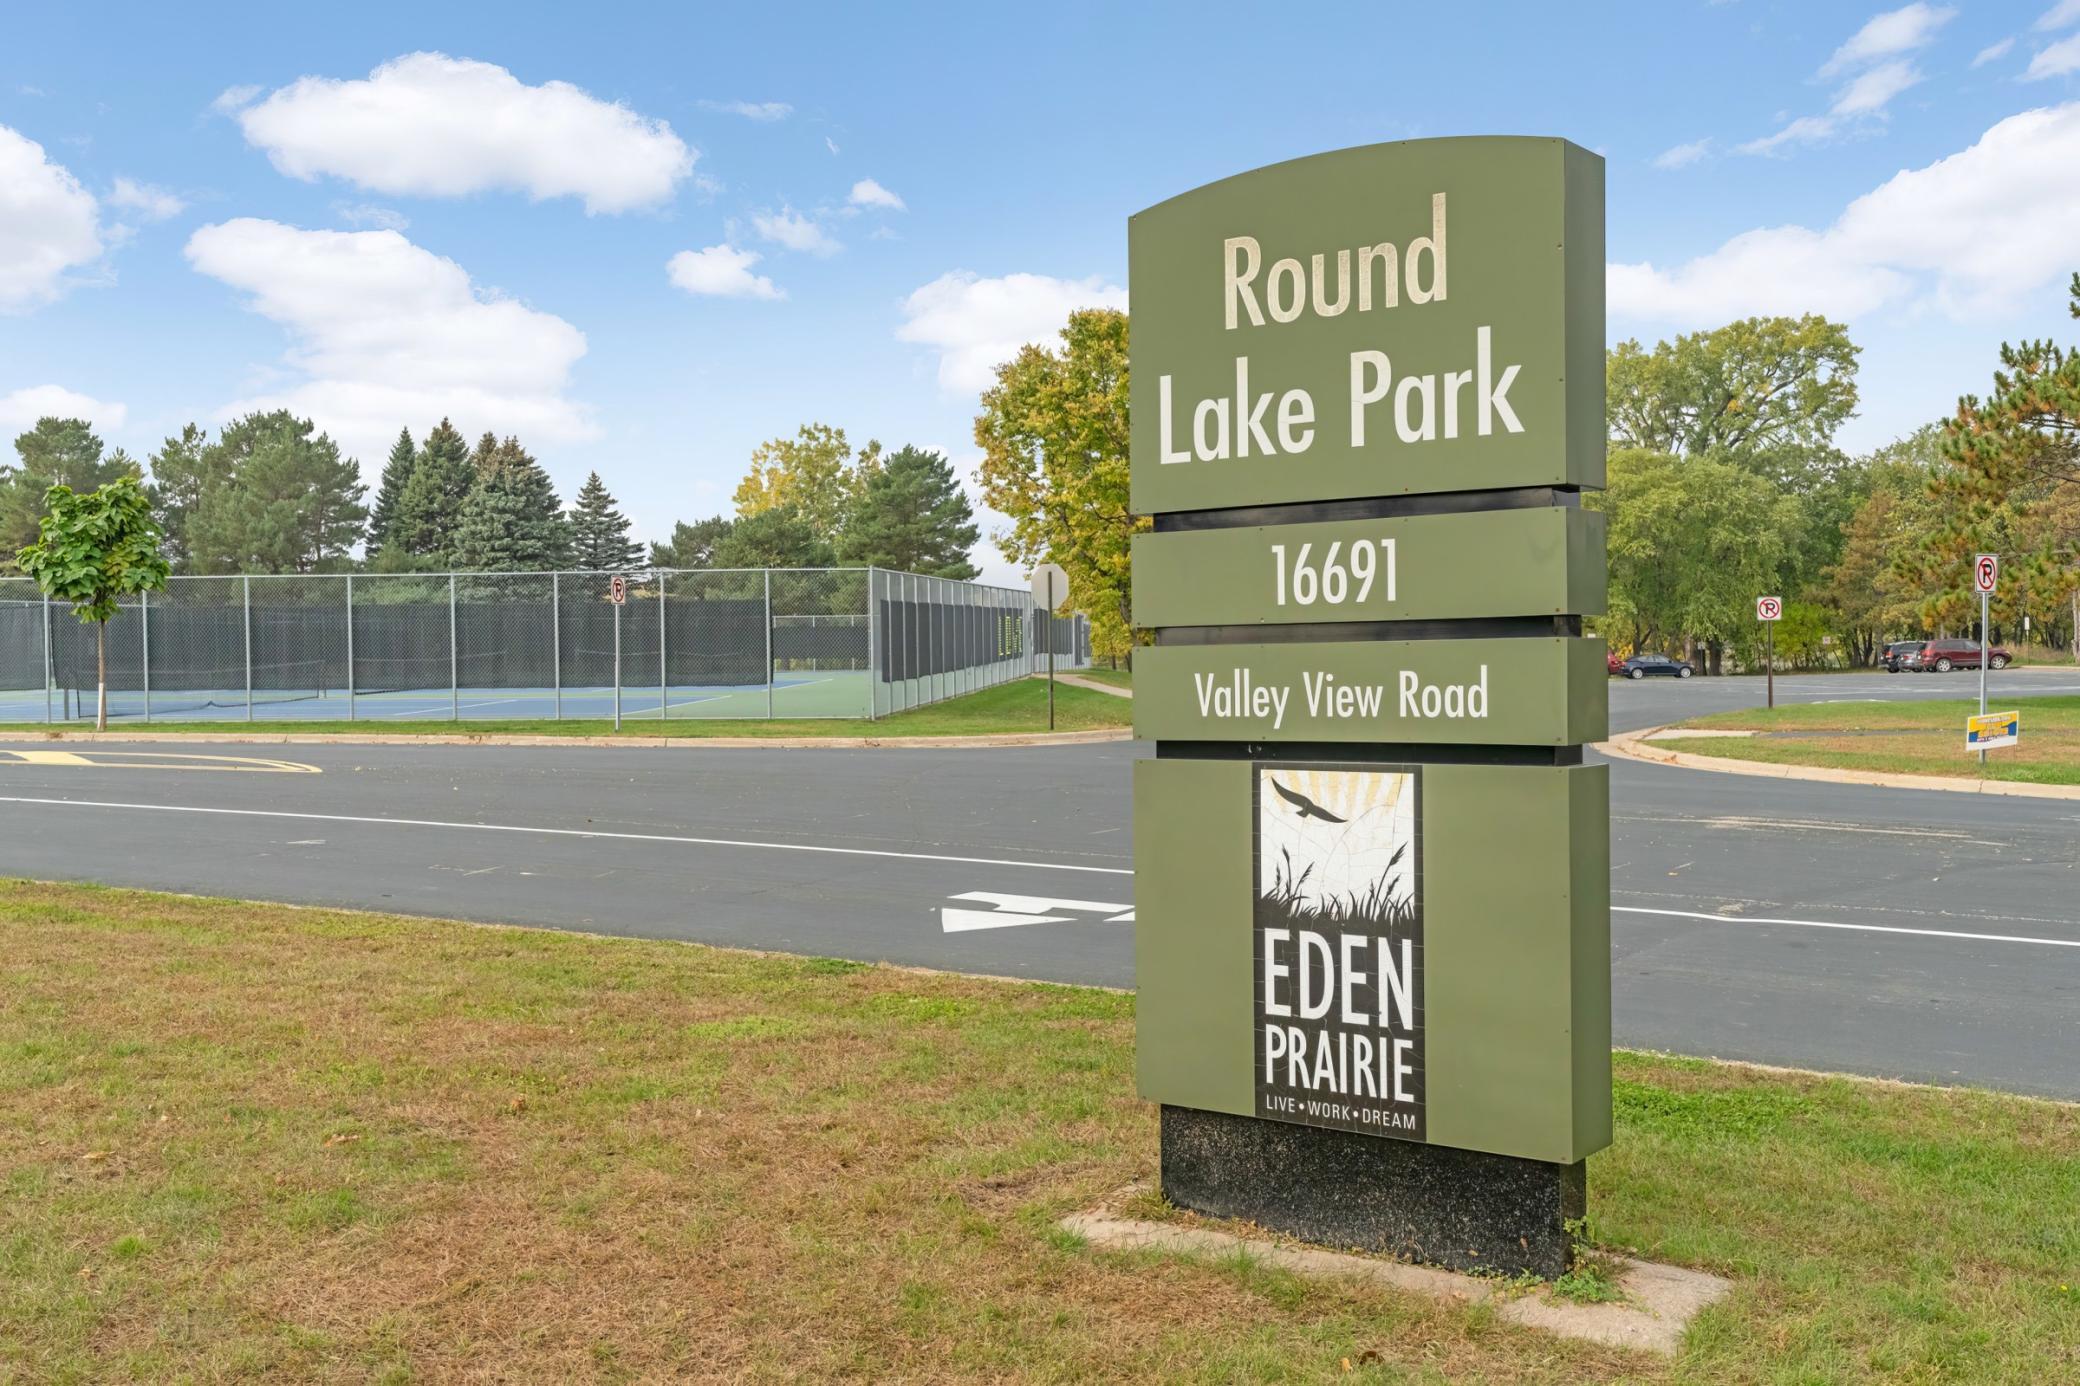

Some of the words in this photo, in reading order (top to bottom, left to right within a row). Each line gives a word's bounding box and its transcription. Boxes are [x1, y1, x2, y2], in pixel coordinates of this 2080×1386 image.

[1225, 193, 1446, 329] Round
[1160, 357, 1314, 464] Lake
[1351, 326, 1524, 447] Park
[1272, 539, 1395, 605] 16691
[1195, 669, 1289, 729] Valley
[1303, 672, 1383, 717] View
[1400, 665, 1487, 717] Road
[1265, 928, 1412, 1030] EDEN
[1266, 1022, 1414, 1102] PRAIRIE
[1266, 1094, 1295, 1113] LIVE
[1307, 1100, 1350, 1121] WORK
[1362, 1108, 1416, 1130] DREAM
